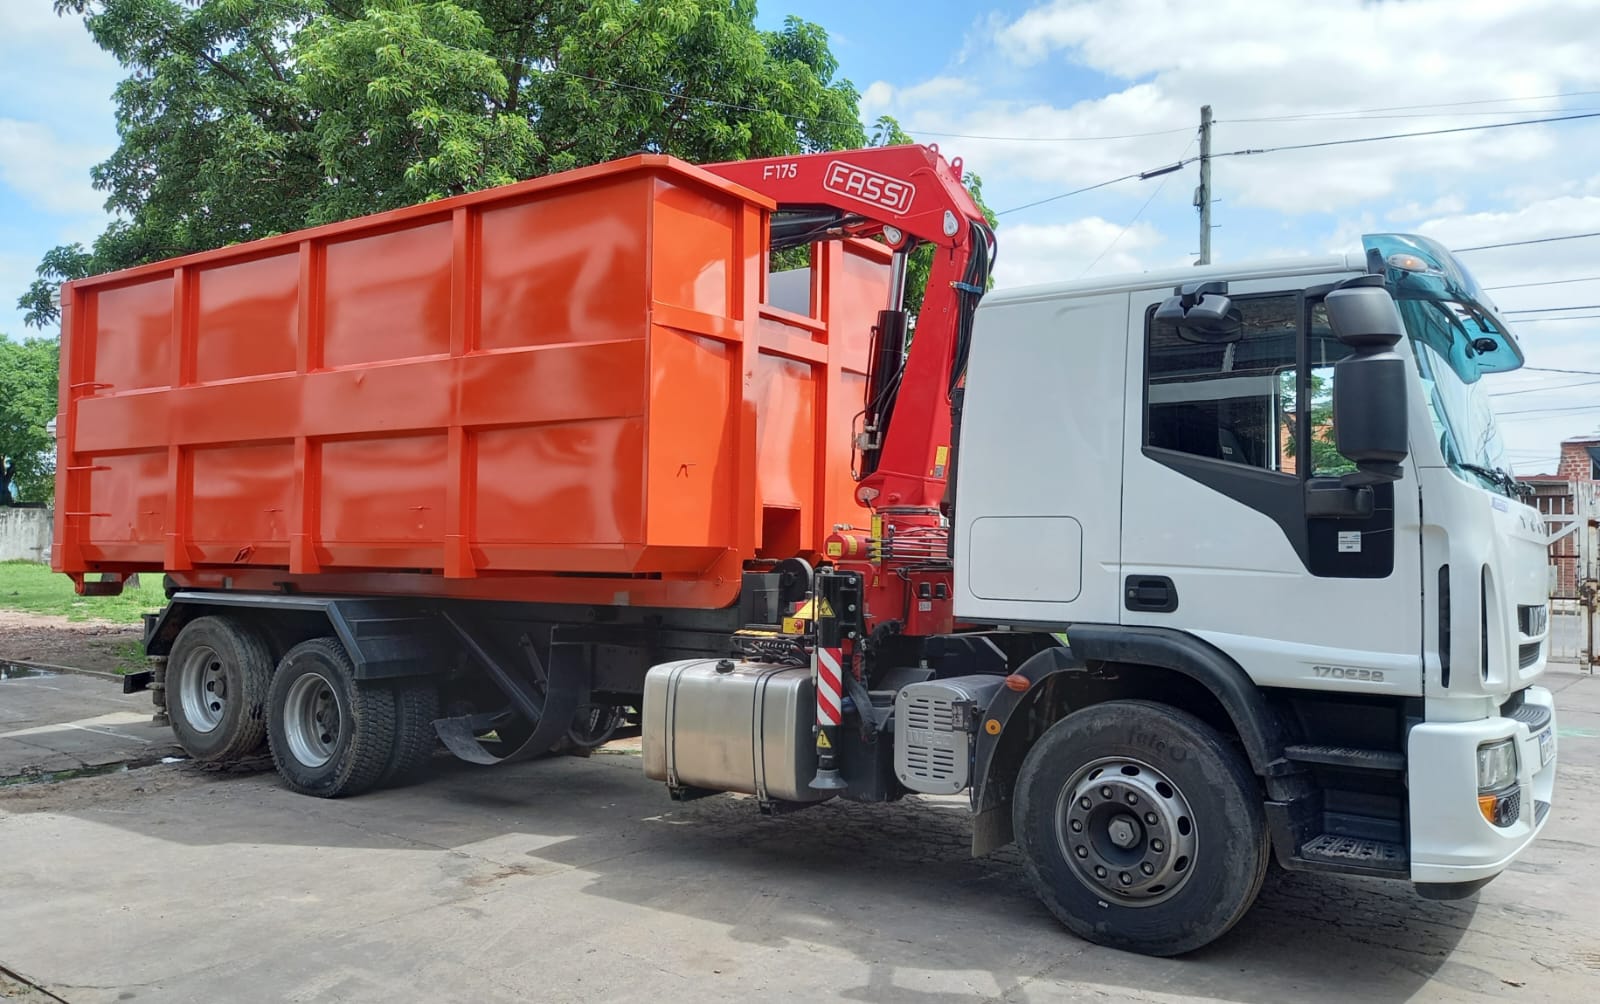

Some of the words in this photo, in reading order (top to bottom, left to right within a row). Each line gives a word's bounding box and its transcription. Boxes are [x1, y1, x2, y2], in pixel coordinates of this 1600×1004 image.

[763, 163, 798, 181] F175
[830, 166, 909, 209] FASSI
[1312, 665, 1384, 682] 170E28
